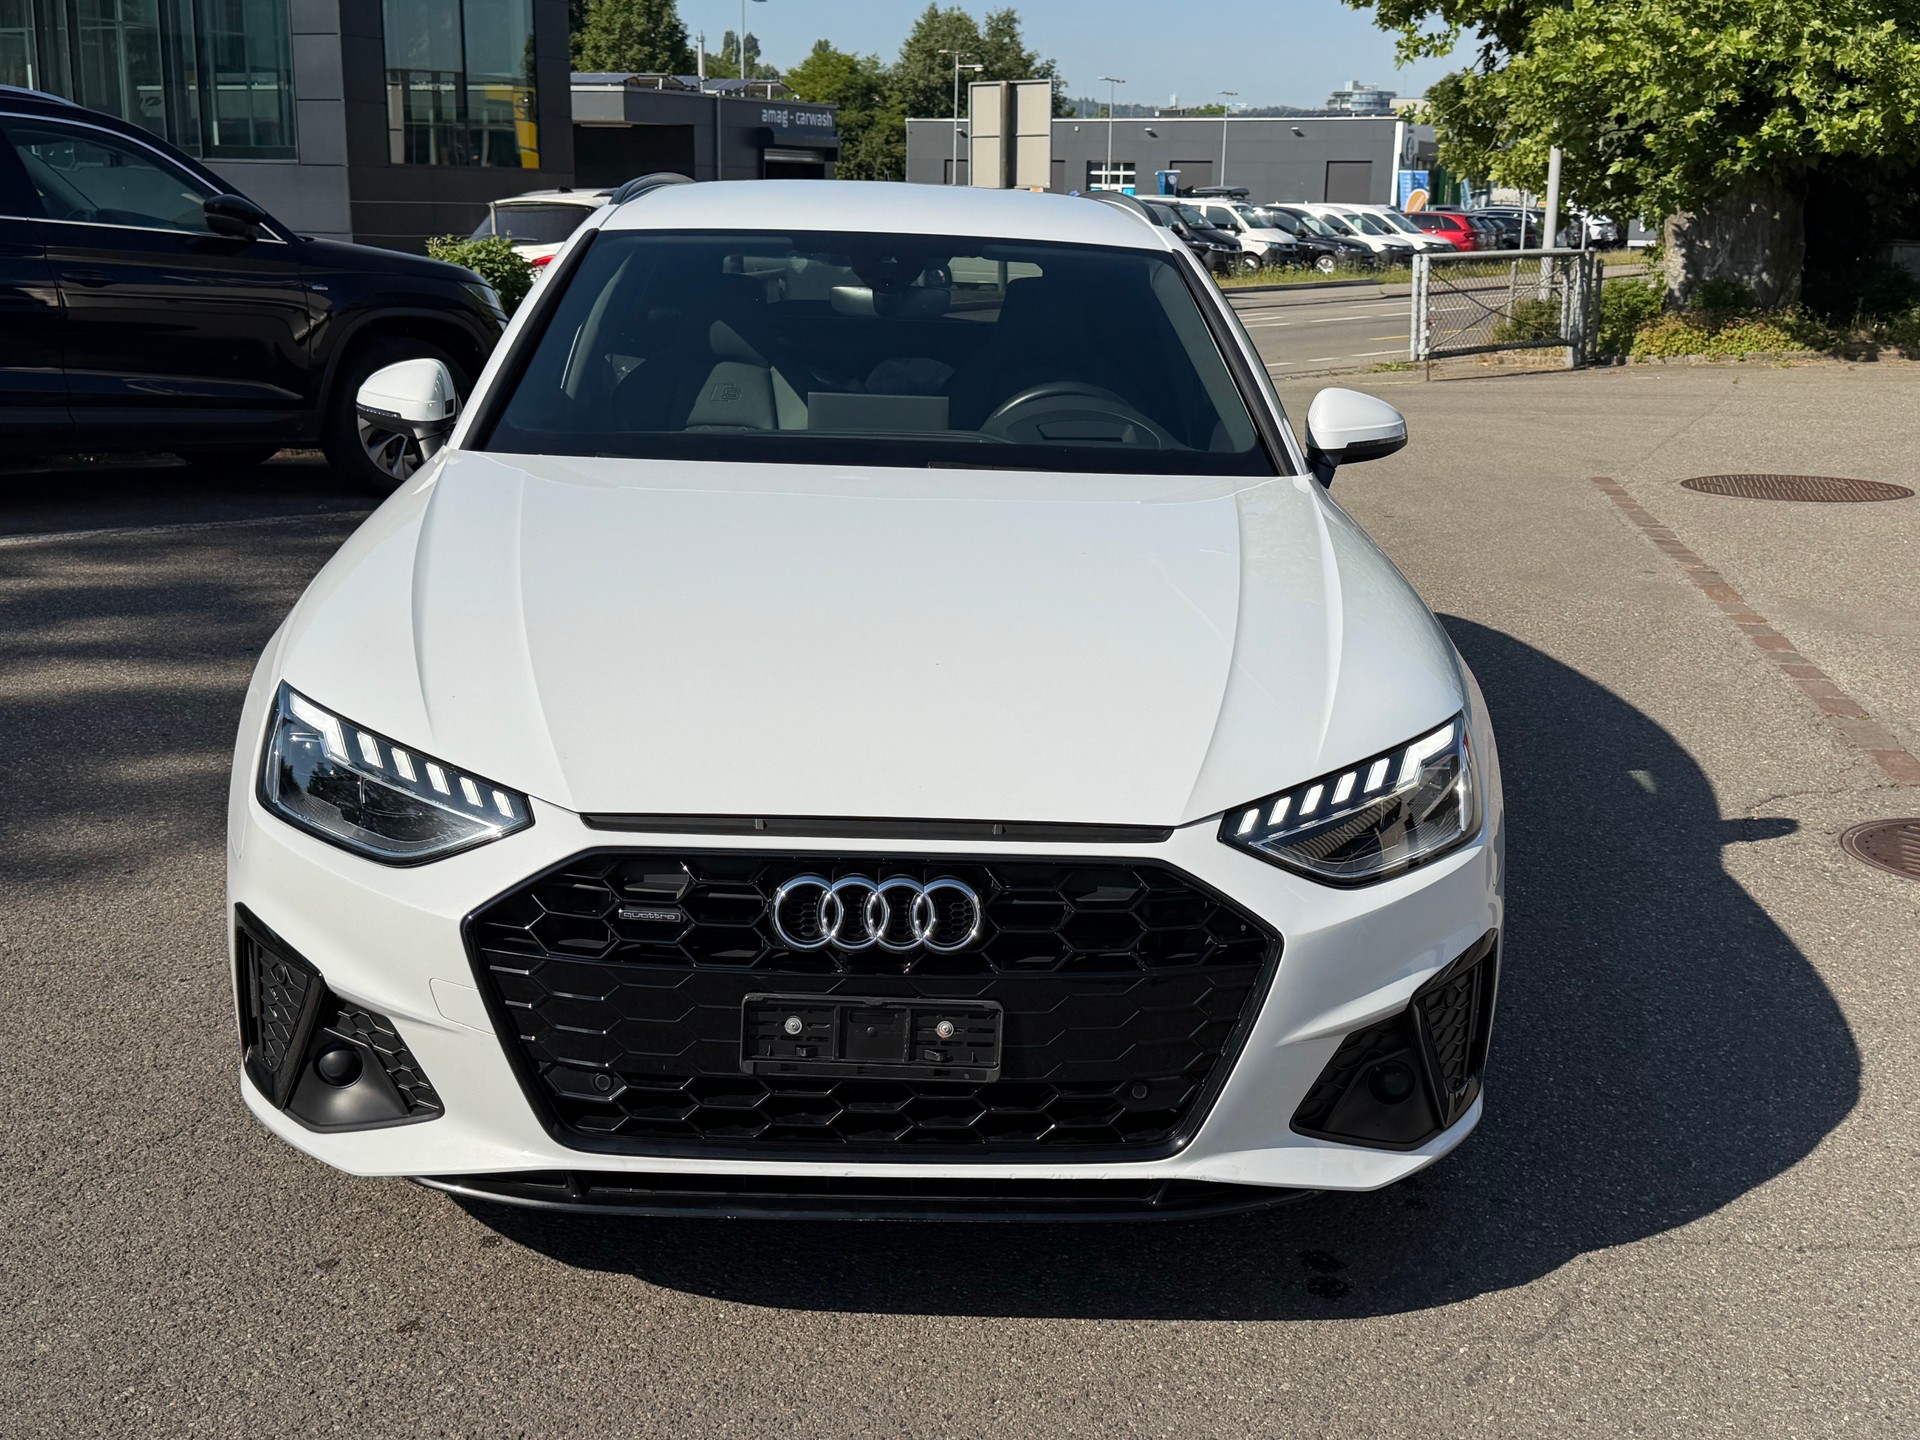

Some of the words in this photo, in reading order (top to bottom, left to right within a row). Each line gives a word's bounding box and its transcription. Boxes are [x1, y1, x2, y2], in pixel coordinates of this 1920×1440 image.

[761, 108, 789, 128] amag
[795, 111, 833, 127] carwash
[623, 911, 676, 920] quattro
